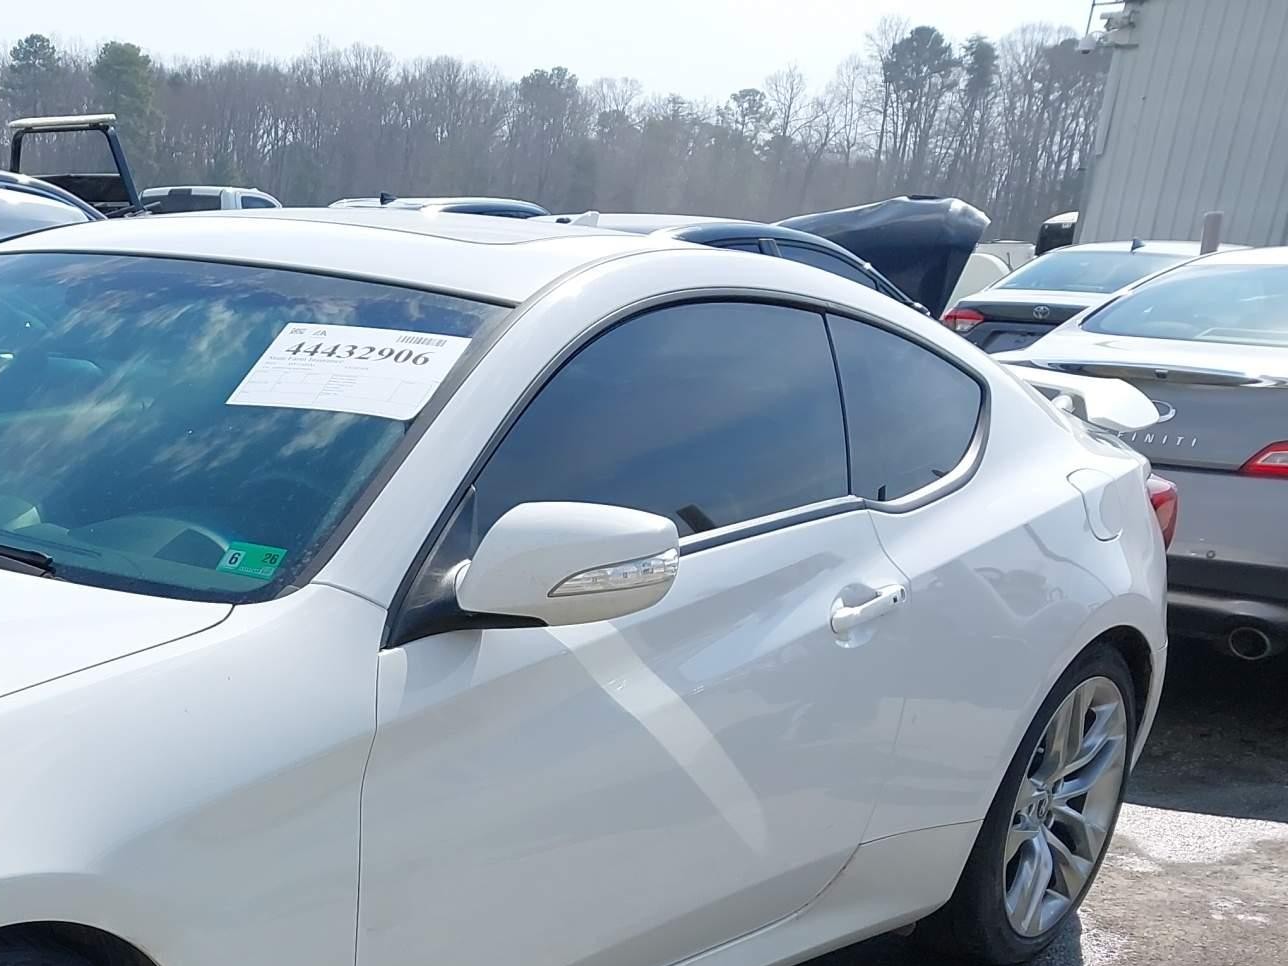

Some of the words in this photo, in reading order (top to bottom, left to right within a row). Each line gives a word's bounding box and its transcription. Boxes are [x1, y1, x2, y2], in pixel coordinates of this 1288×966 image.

[285, 341, 435, 366] 44432906
[1117, 431, 1197, 447] FINITI
[228, 552, 241, 565] 6
[262, 552, 280, 565] 26
